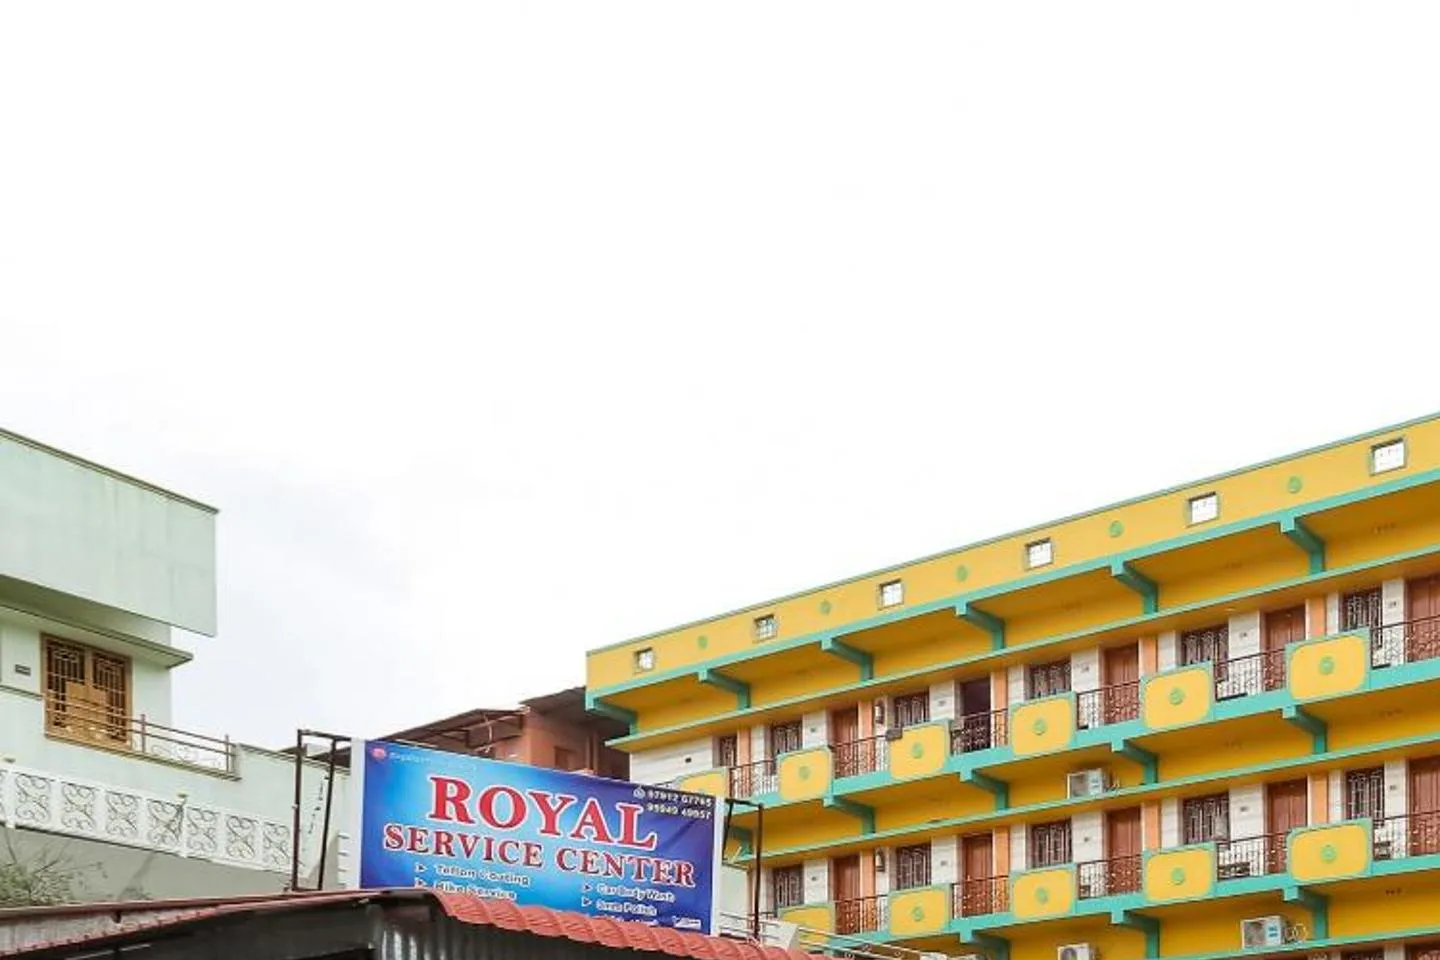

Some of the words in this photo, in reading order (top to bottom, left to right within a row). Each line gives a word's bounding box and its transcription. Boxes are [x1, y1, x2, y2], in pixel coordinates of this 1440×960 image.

[428, 776, 658, 850] ROYAL
[383, 824, 544, 868] SERVICE
[556, 847, 697, 888] CENTER
[435, 864, 476, 879] Teflon
[477, 868, 531, 888] Coating
